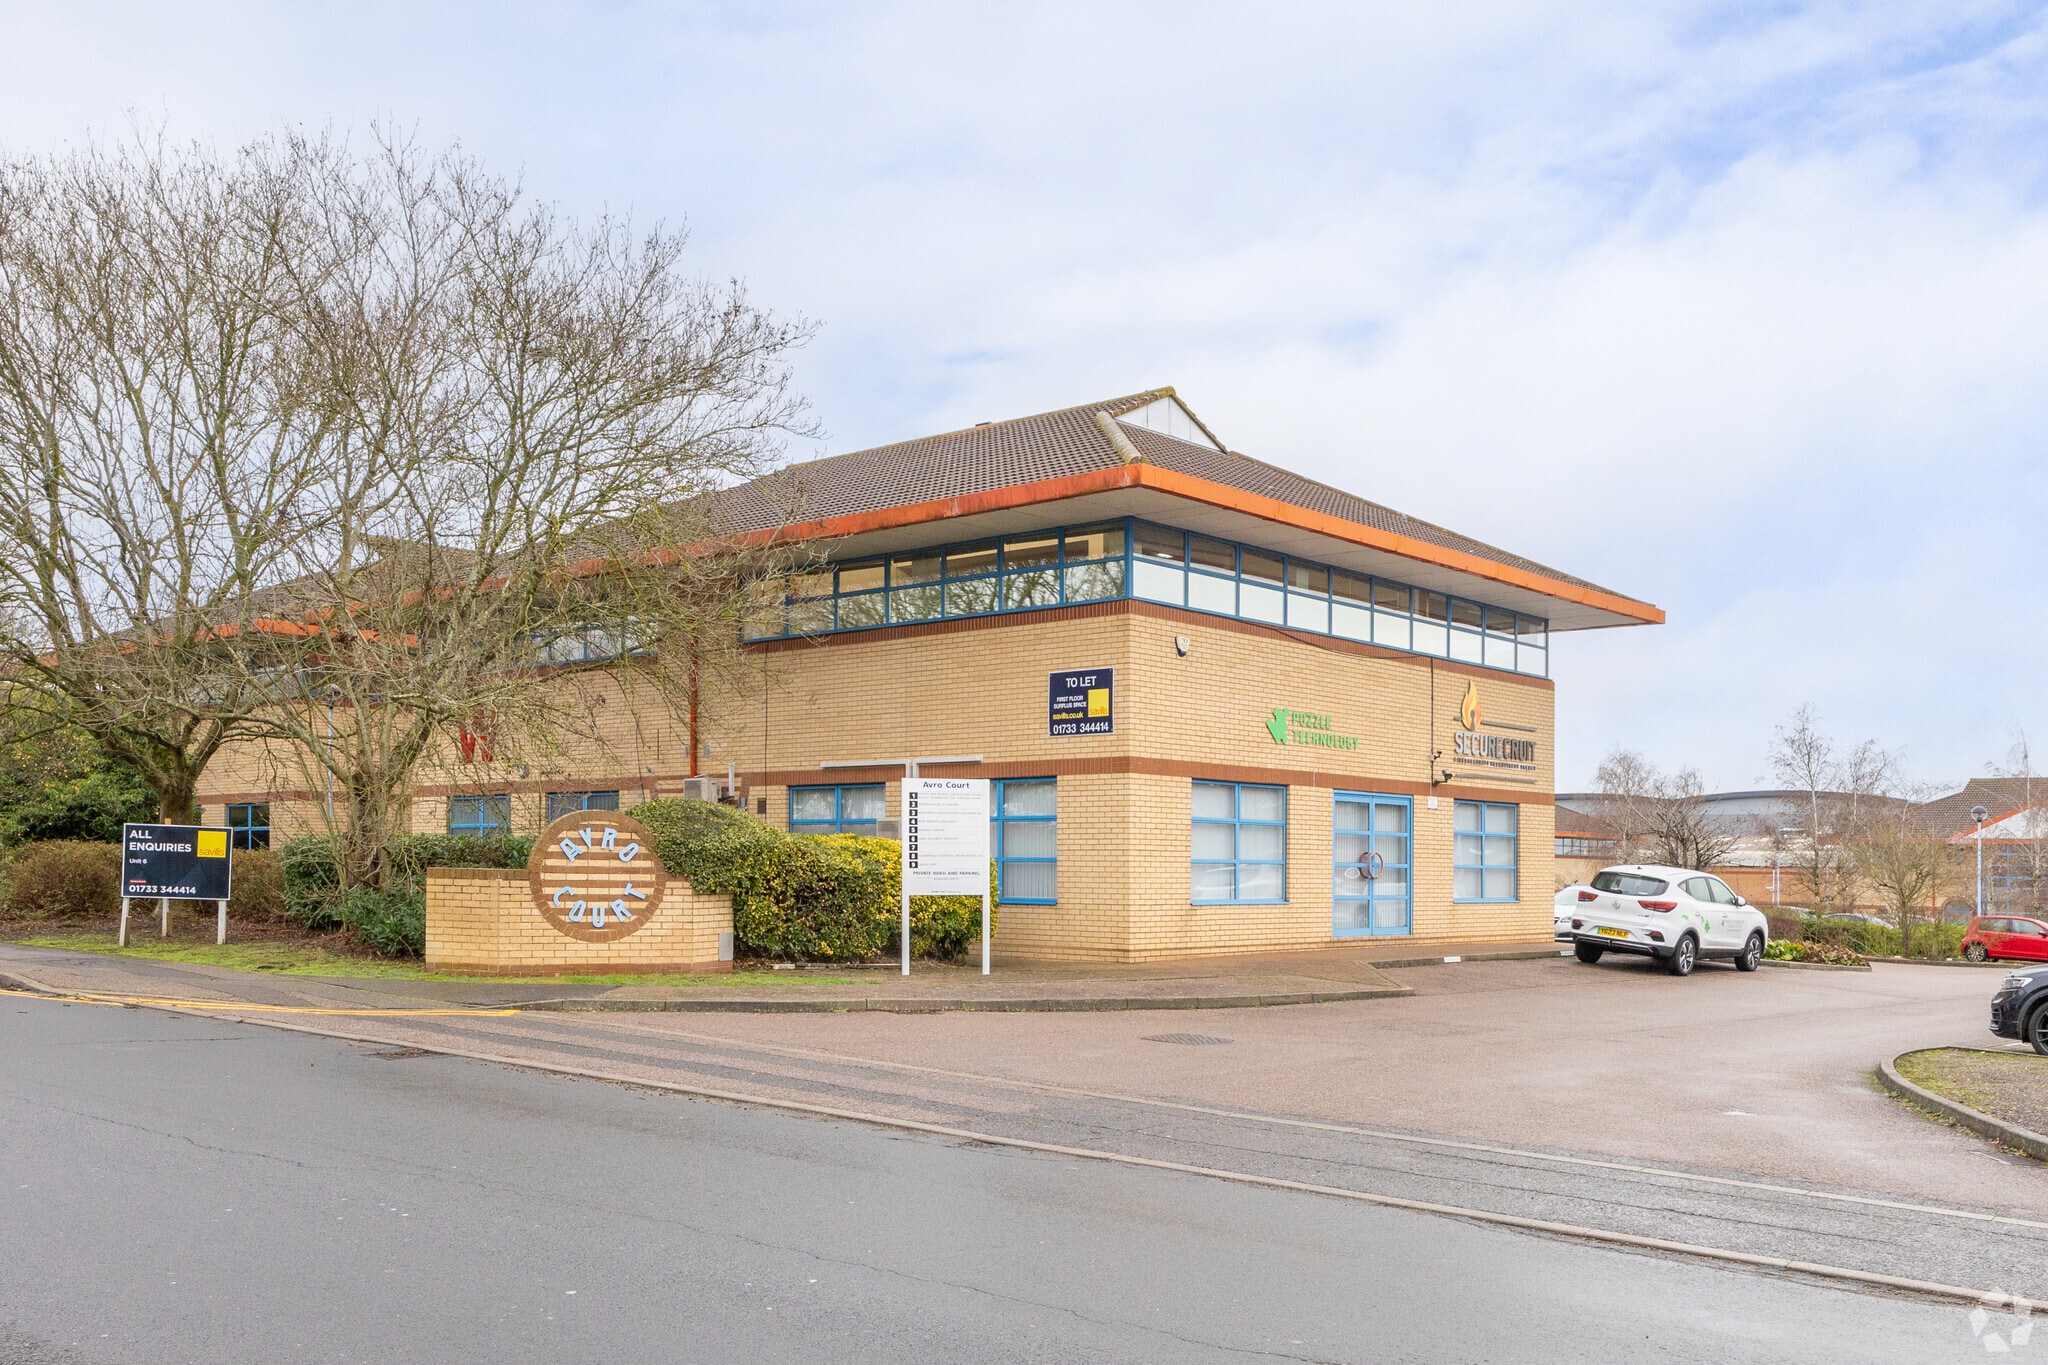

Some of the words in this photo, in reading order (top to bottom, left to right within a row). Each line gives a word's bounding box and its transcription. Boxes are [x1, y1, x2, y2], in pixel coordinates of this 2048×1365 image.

[1066, 678, 1078, 688] TO
[1080, 676, 1096, 687] LET
[1292, 710, 1332, 730] PUZZLE
[1053, 724, 1076, 734] 01733
[1080, 722, 1109, 732] 344414
[1292, 729, 1360, 750] TECHNOLOGY
[1454, 731, 1536, 762] SECURECRUIT
[129, 830, 152, 839] ALL
[129, 842, 192, 852] ENQUIRIES
[560, 827, 640, 862] AVRO
[200, 848, 225, 856] savills
[129, 885, 158, 893] 01733
[160, 886, 196, 894] 344414
[553, 883, 646, 928] COURT
